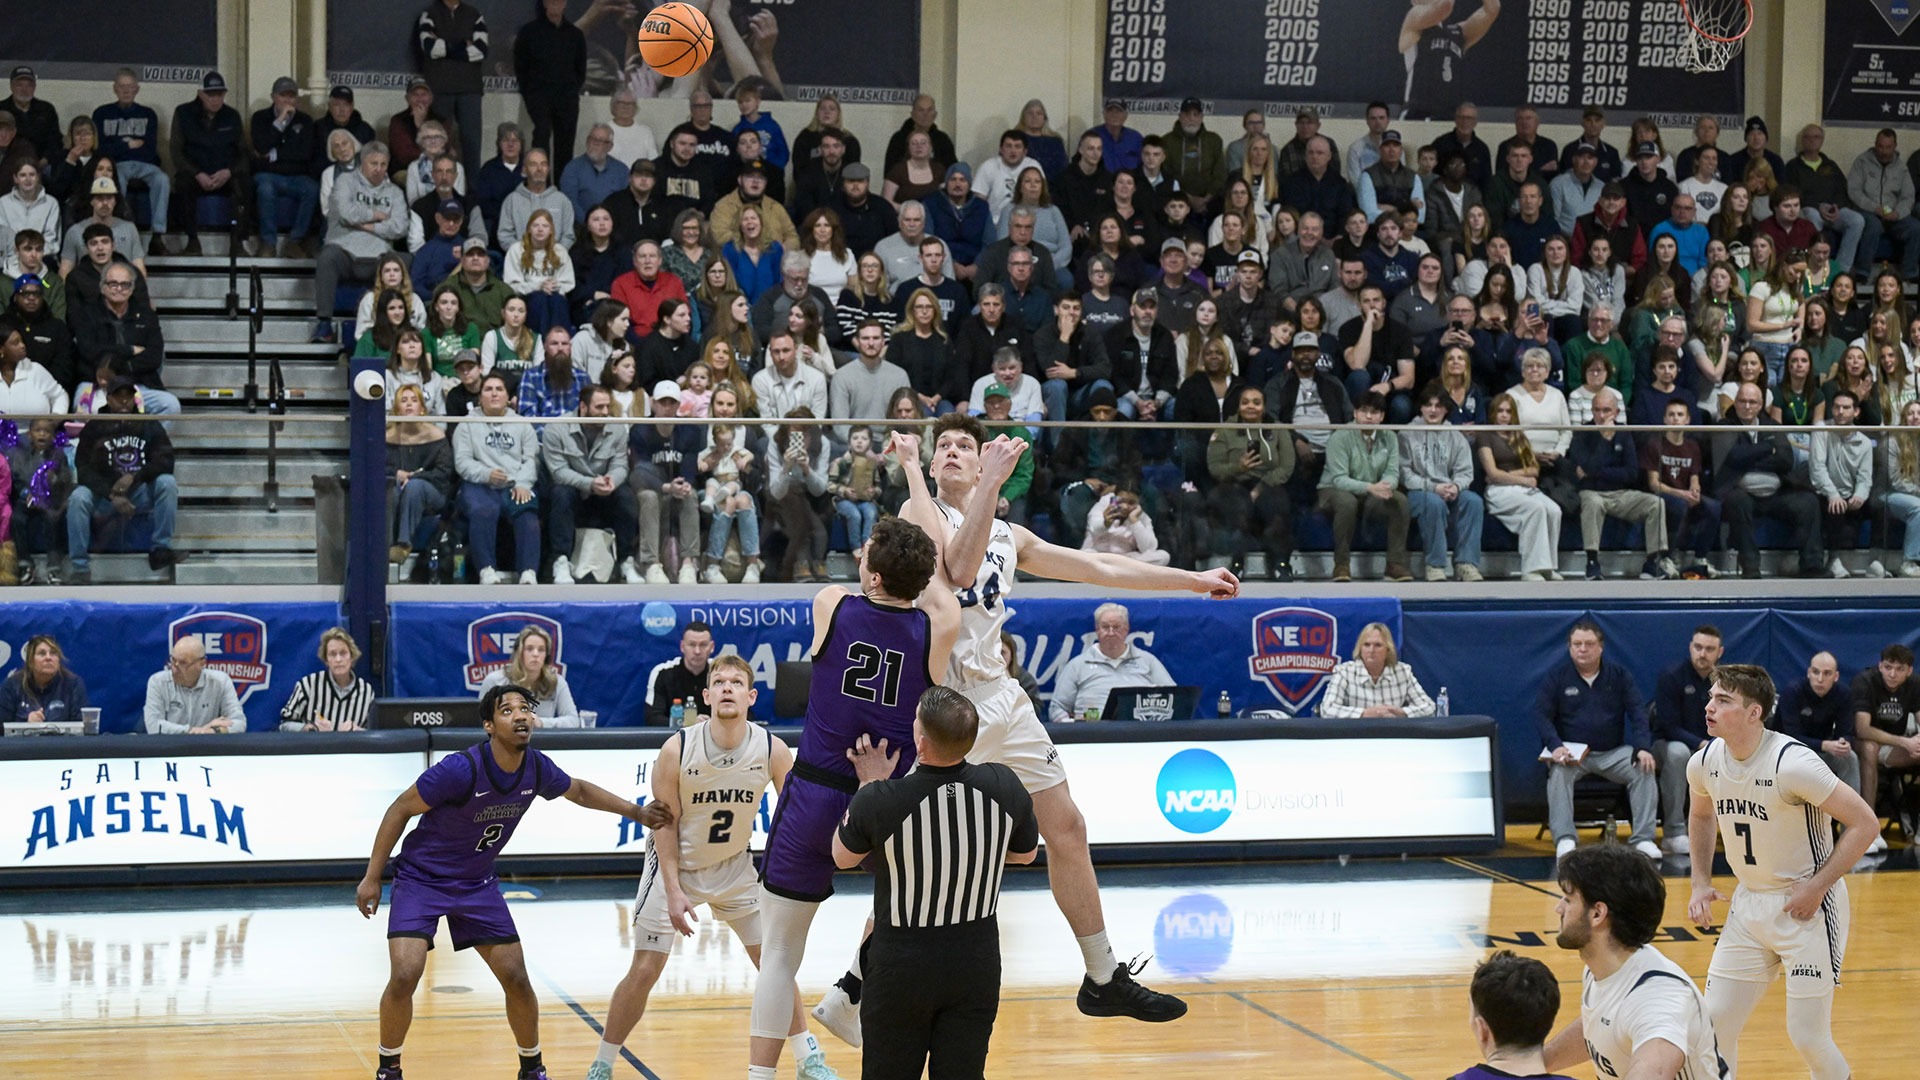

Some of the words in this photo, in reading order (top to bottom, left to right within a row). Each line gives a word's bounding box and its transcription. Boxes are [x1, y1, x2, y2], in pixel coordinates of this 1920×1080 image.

[1582, 1, 1630, 20] 2006
[1110, 14, 1166, 36] 2014
[1264, 18, 1320, 40] 2006
[1528, 20, 1571, 40] 1993
[1582, 22, 1629, 42] 2010
[1110, 38, 1166, 60] 2018
[1265, 42, 1319, 63] 2017
[1527, 41, 1571, 62] 1994
[1582, 43, 1628, 63] 2013
[331, 73, 384, 87] REGULAR
[1109, 60, 1166, 83] 2019
[1264, 65, 1317, 86] 2020
[1527, 63, 1571, 83] 1995
[1582, 64, 1628, 84] 2014
[852, 89, 917, 102] BASKETBALL
[1527, 84, 1571, 104] 1996
[1581, 86, 1628, 106] 2015
[644, 616, 676, 628] NCAA
[691, 607, 796, 627] DIVISION
[1265, 626, 1327, 646] NE10
[841, 640, 905, 707] 21
[1255, 655, 1335, 671] CHAMPIONSHIP
[413, 711, 445, 726] POSS
[60, 760, 213, 791] SAINT
[691, 788, 755, 804] HAWKS
[1164, 789, 1236, 813] NCAA
[1245, 790, 1328, 810] Division
[1716, 798, 1769, 821] HAWKS
[22, 791, 254, 861] ANSELM
[707, 809, 735, 844] 2
[475, 823, 505, 852] 2
[1734, 822, 1758, 866] 7
[1790, 968, 1822, 979] ANSELM
